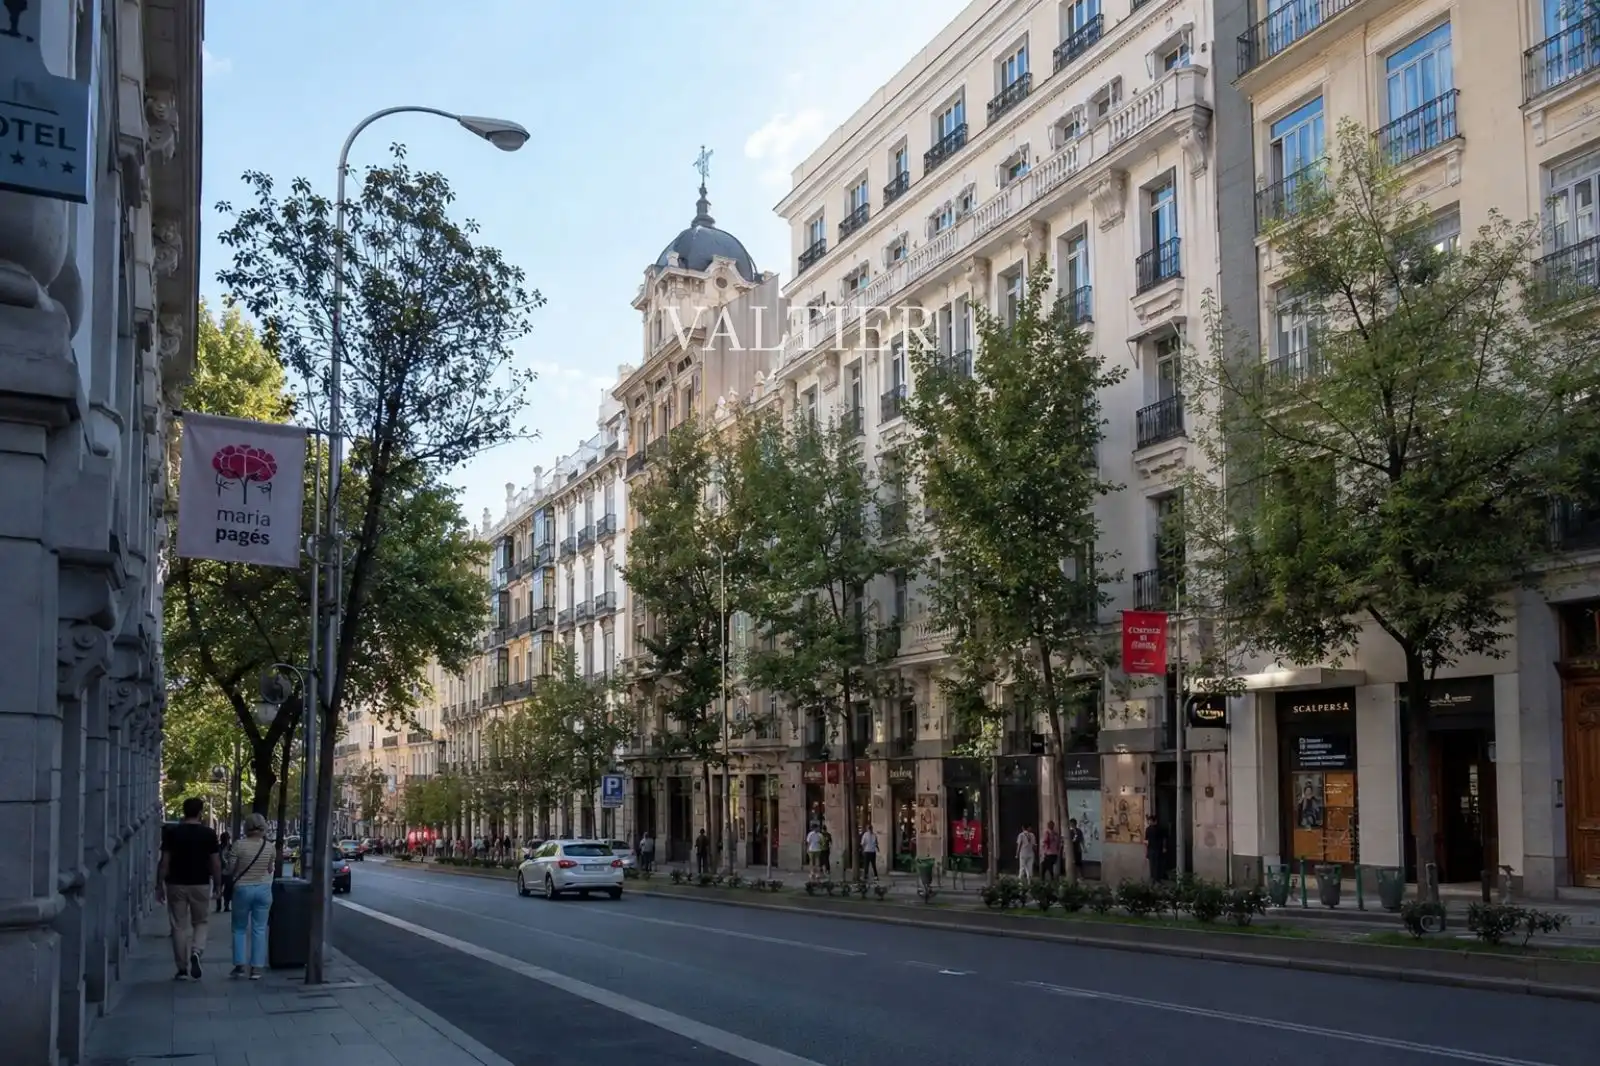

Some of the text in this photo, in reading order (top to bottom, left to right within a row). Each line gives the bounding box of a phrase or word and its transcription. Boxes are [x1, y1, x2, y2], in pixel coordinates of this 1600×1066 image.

[216, 528, 270, 547] pagés
[1293, 703, 1342, 714] SCALPERS
[607, 778, 619, 795] P
